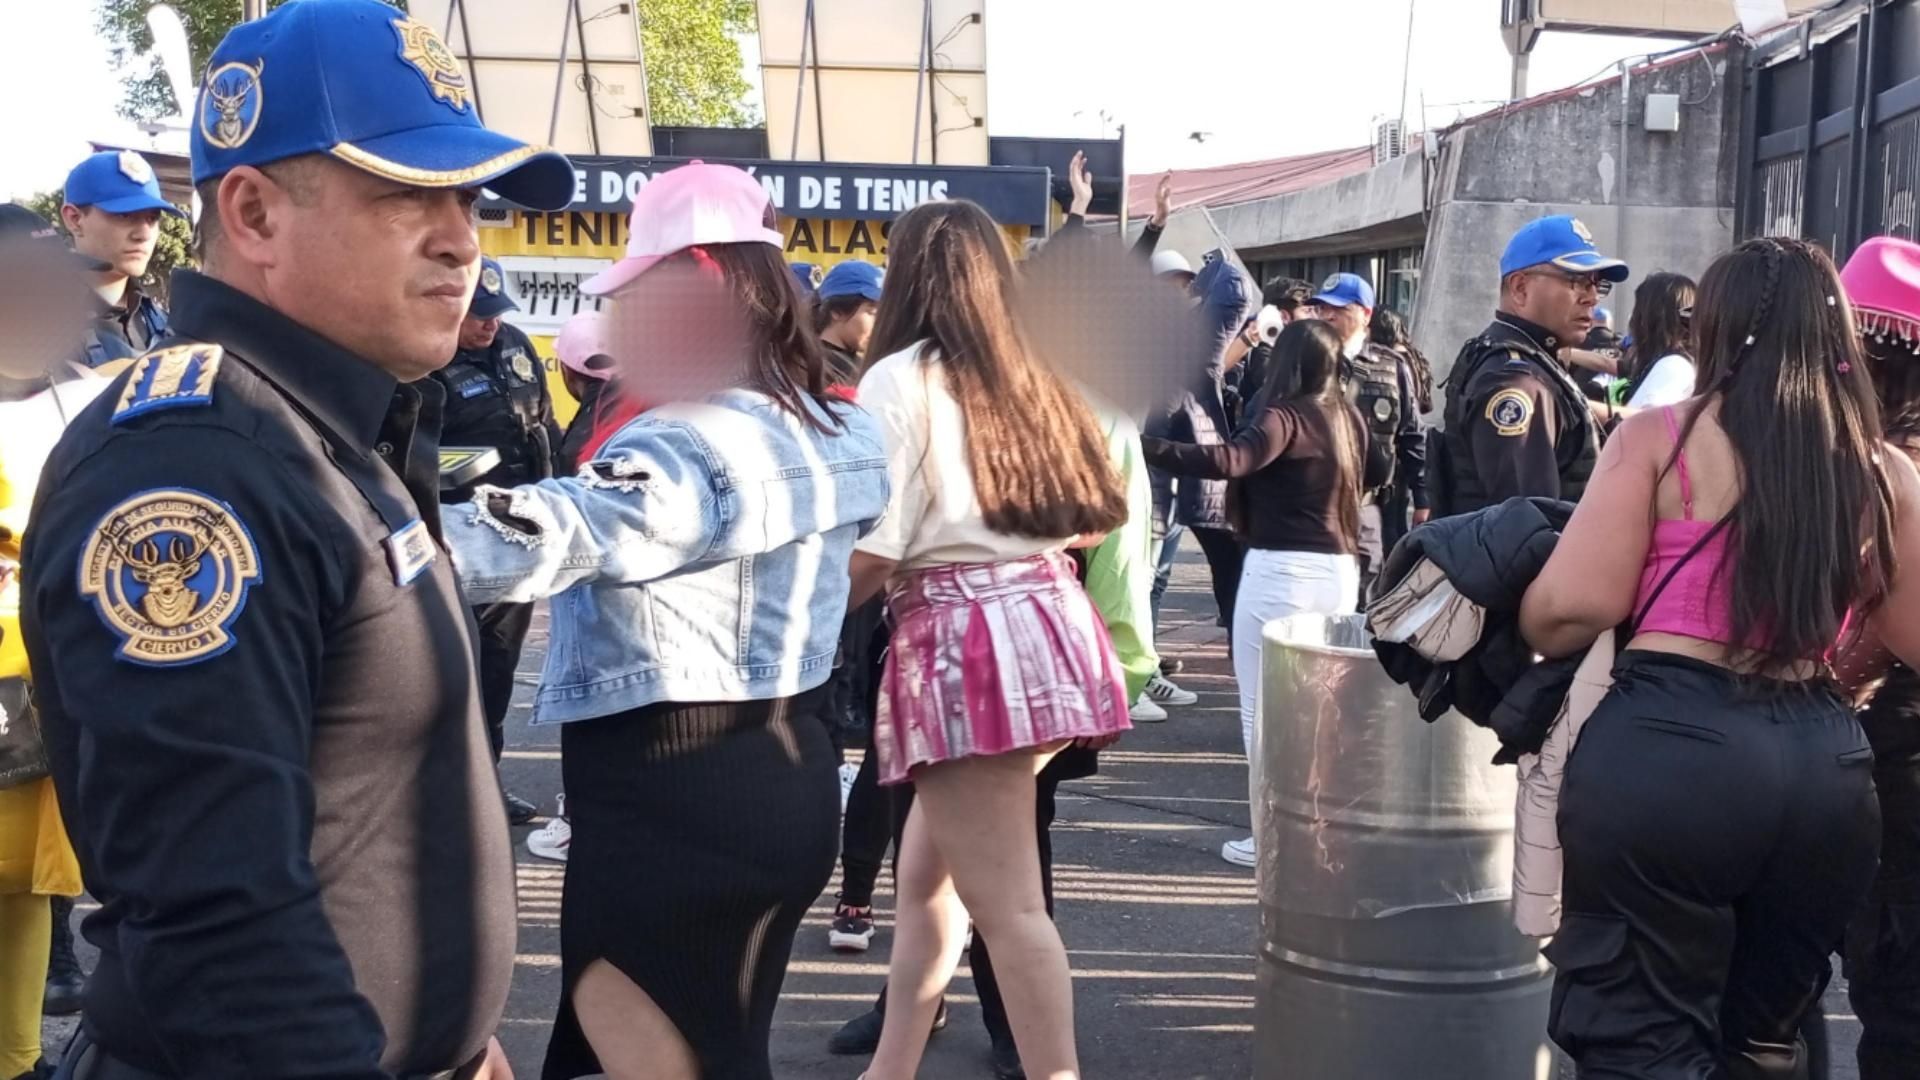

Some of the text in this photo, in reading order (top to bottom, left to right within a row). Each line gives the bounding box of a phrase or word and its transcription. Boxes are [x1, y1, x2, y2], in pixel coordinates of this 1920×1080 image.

[571, 170, 587, 203] E
[799, 176, 842, 210] DE
[853, 178, 948, 212] TENIS
[522, 211, 888, 255] TENI ALA
[140, 637, 202, 655] CIERVO
